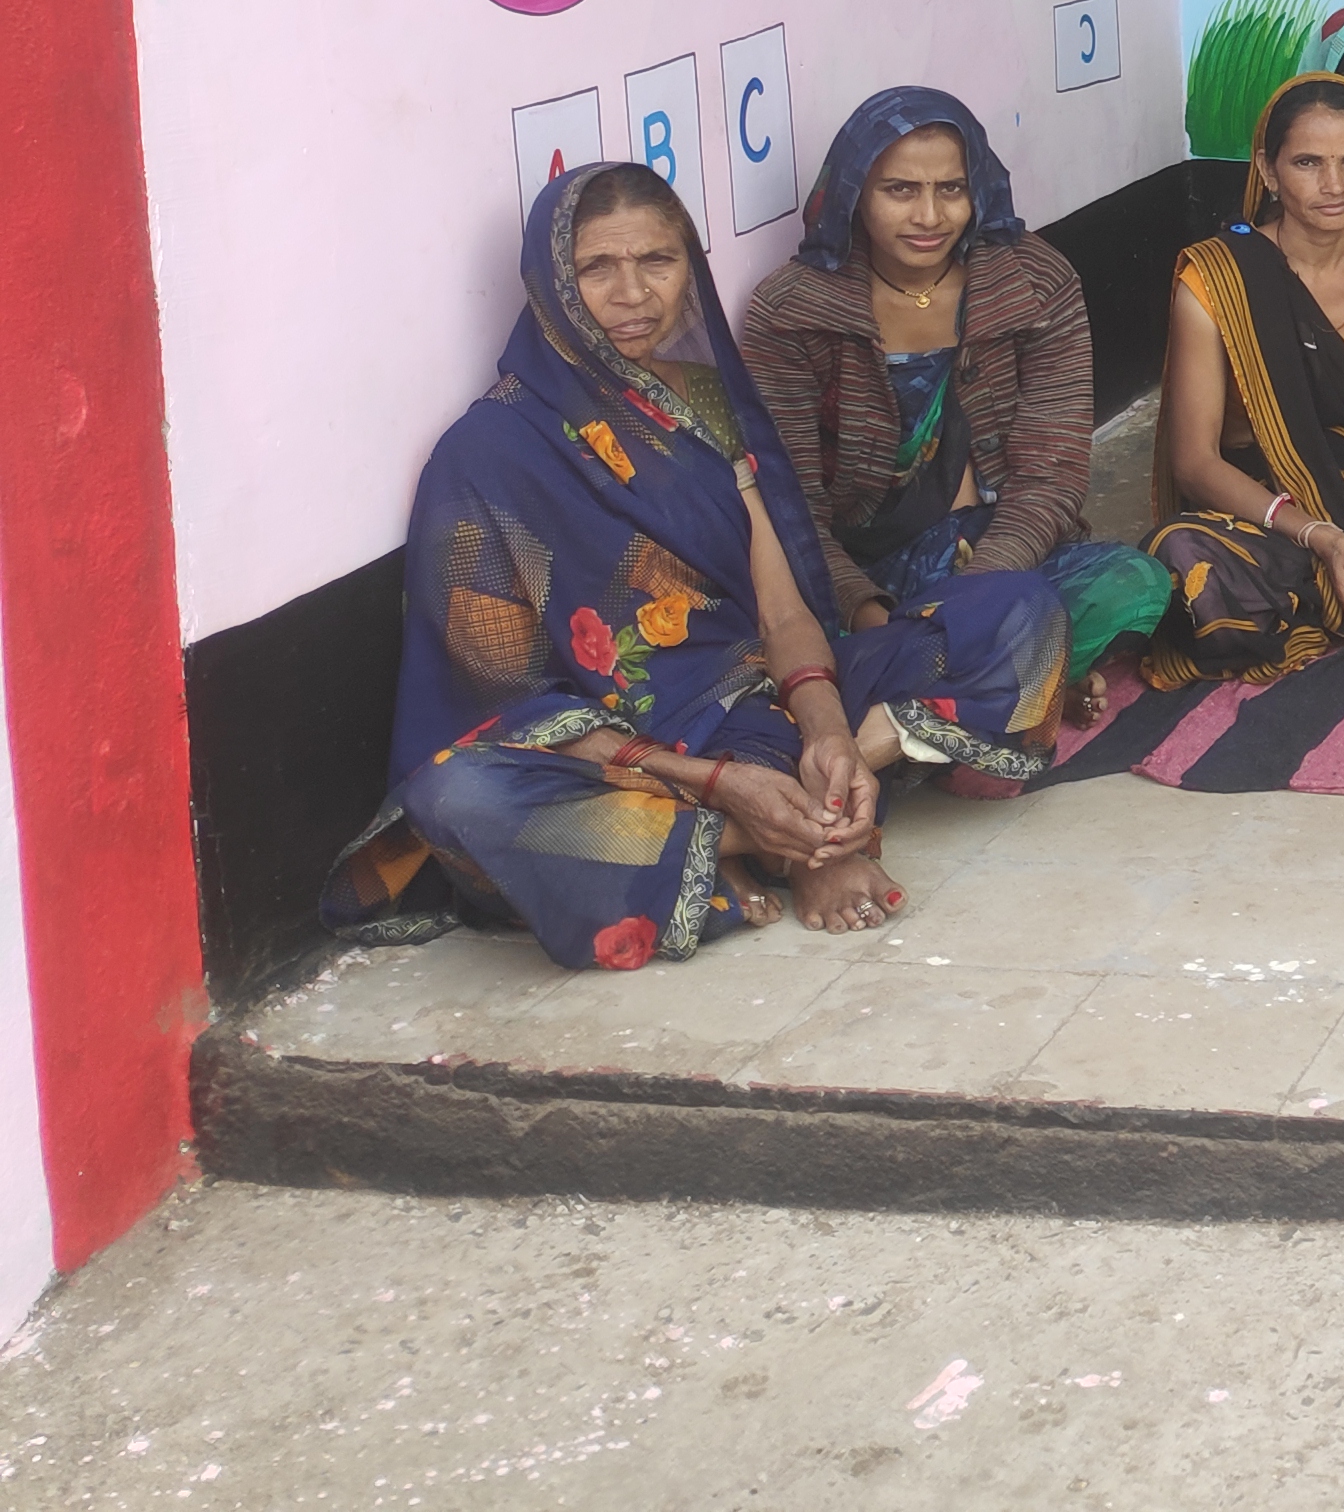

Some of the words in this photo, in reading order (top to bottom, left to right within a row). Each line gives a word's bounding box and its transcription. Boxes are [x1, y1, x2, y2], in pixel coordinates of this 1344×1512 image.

[1079, 13, 1097, 64] C
[643, 110, 677, 188] B
[739, 76, 772, 164] C
